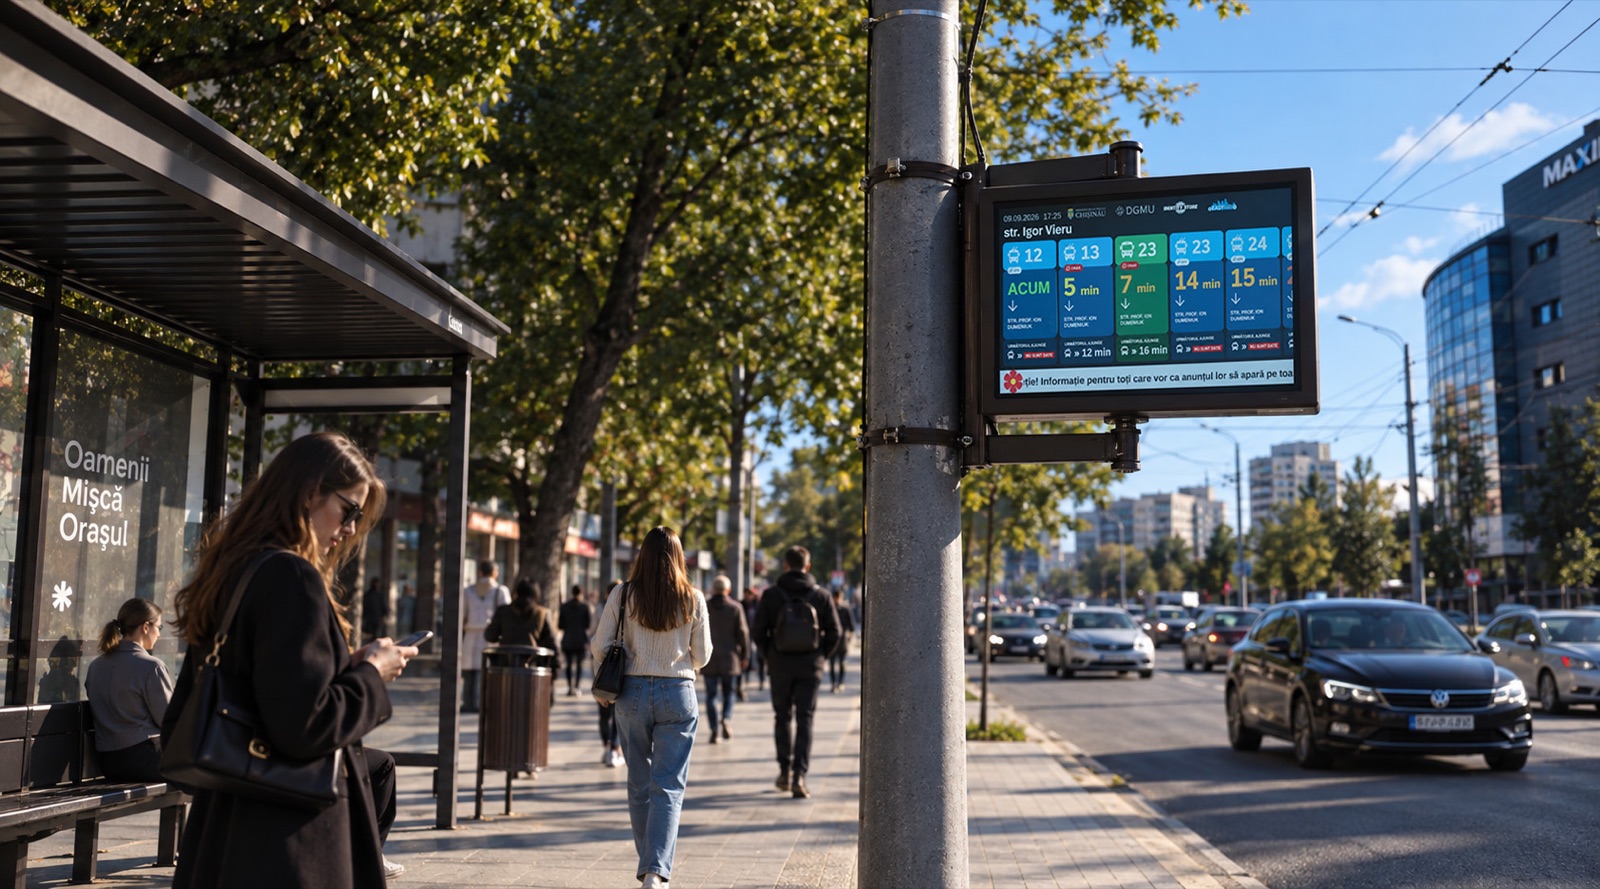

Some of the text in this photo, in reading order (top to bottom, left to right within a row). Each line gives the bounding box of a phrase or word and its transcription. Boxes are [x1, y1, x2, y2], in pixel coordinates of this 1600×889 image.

[1543, 136, 1600, 188] MAXI
[1003, 211, 1062, 223] 09.09.2026 17:25
[1126, 205, 1155, 215] DGMU
[1003, 224, 1072, 239] str. Igor Vieru
[1138, 241, 1157, 257] 23
[1192, 239, 1211, 254] 23
[1248, 236, 1267, 251] 24
[1024, 248, 1042, 263] 12
[1081, 245, 1099, 260] 13
[1120, 275, 1156, 294] 7 min
[1175, 271, 1221, 290] 14 min
[1231, 267, 1278, 287] 15 min
[1007, 281, 1050, 296] ACUM
[1064, 277, 1099, 296] 5 min
[1082, 347, 1112, 357] 12 min
[1139, 345, 1168, 355] 16 min
[1023, 377, 1039, 388] ție!
[1040, 376, 1085, 387] Informație
[1086, 376, 1115, 386] pentru
[1117, 374, 1131, 385] toți
[1132, 375, 1152, 383] care
[1153, 374, 1168, 382] vor
[1181, 371, 1213, 382] anunțul
[1215, 371, 1227, 380] lor
[1228, 370, 1239, 379] să
[1240, 370, 1265, 380] apară
[1266, 371, 1278, 380] pe
[1279, 369, 1293, 378] toa
[64, 440, 150, 482] Oamenii
